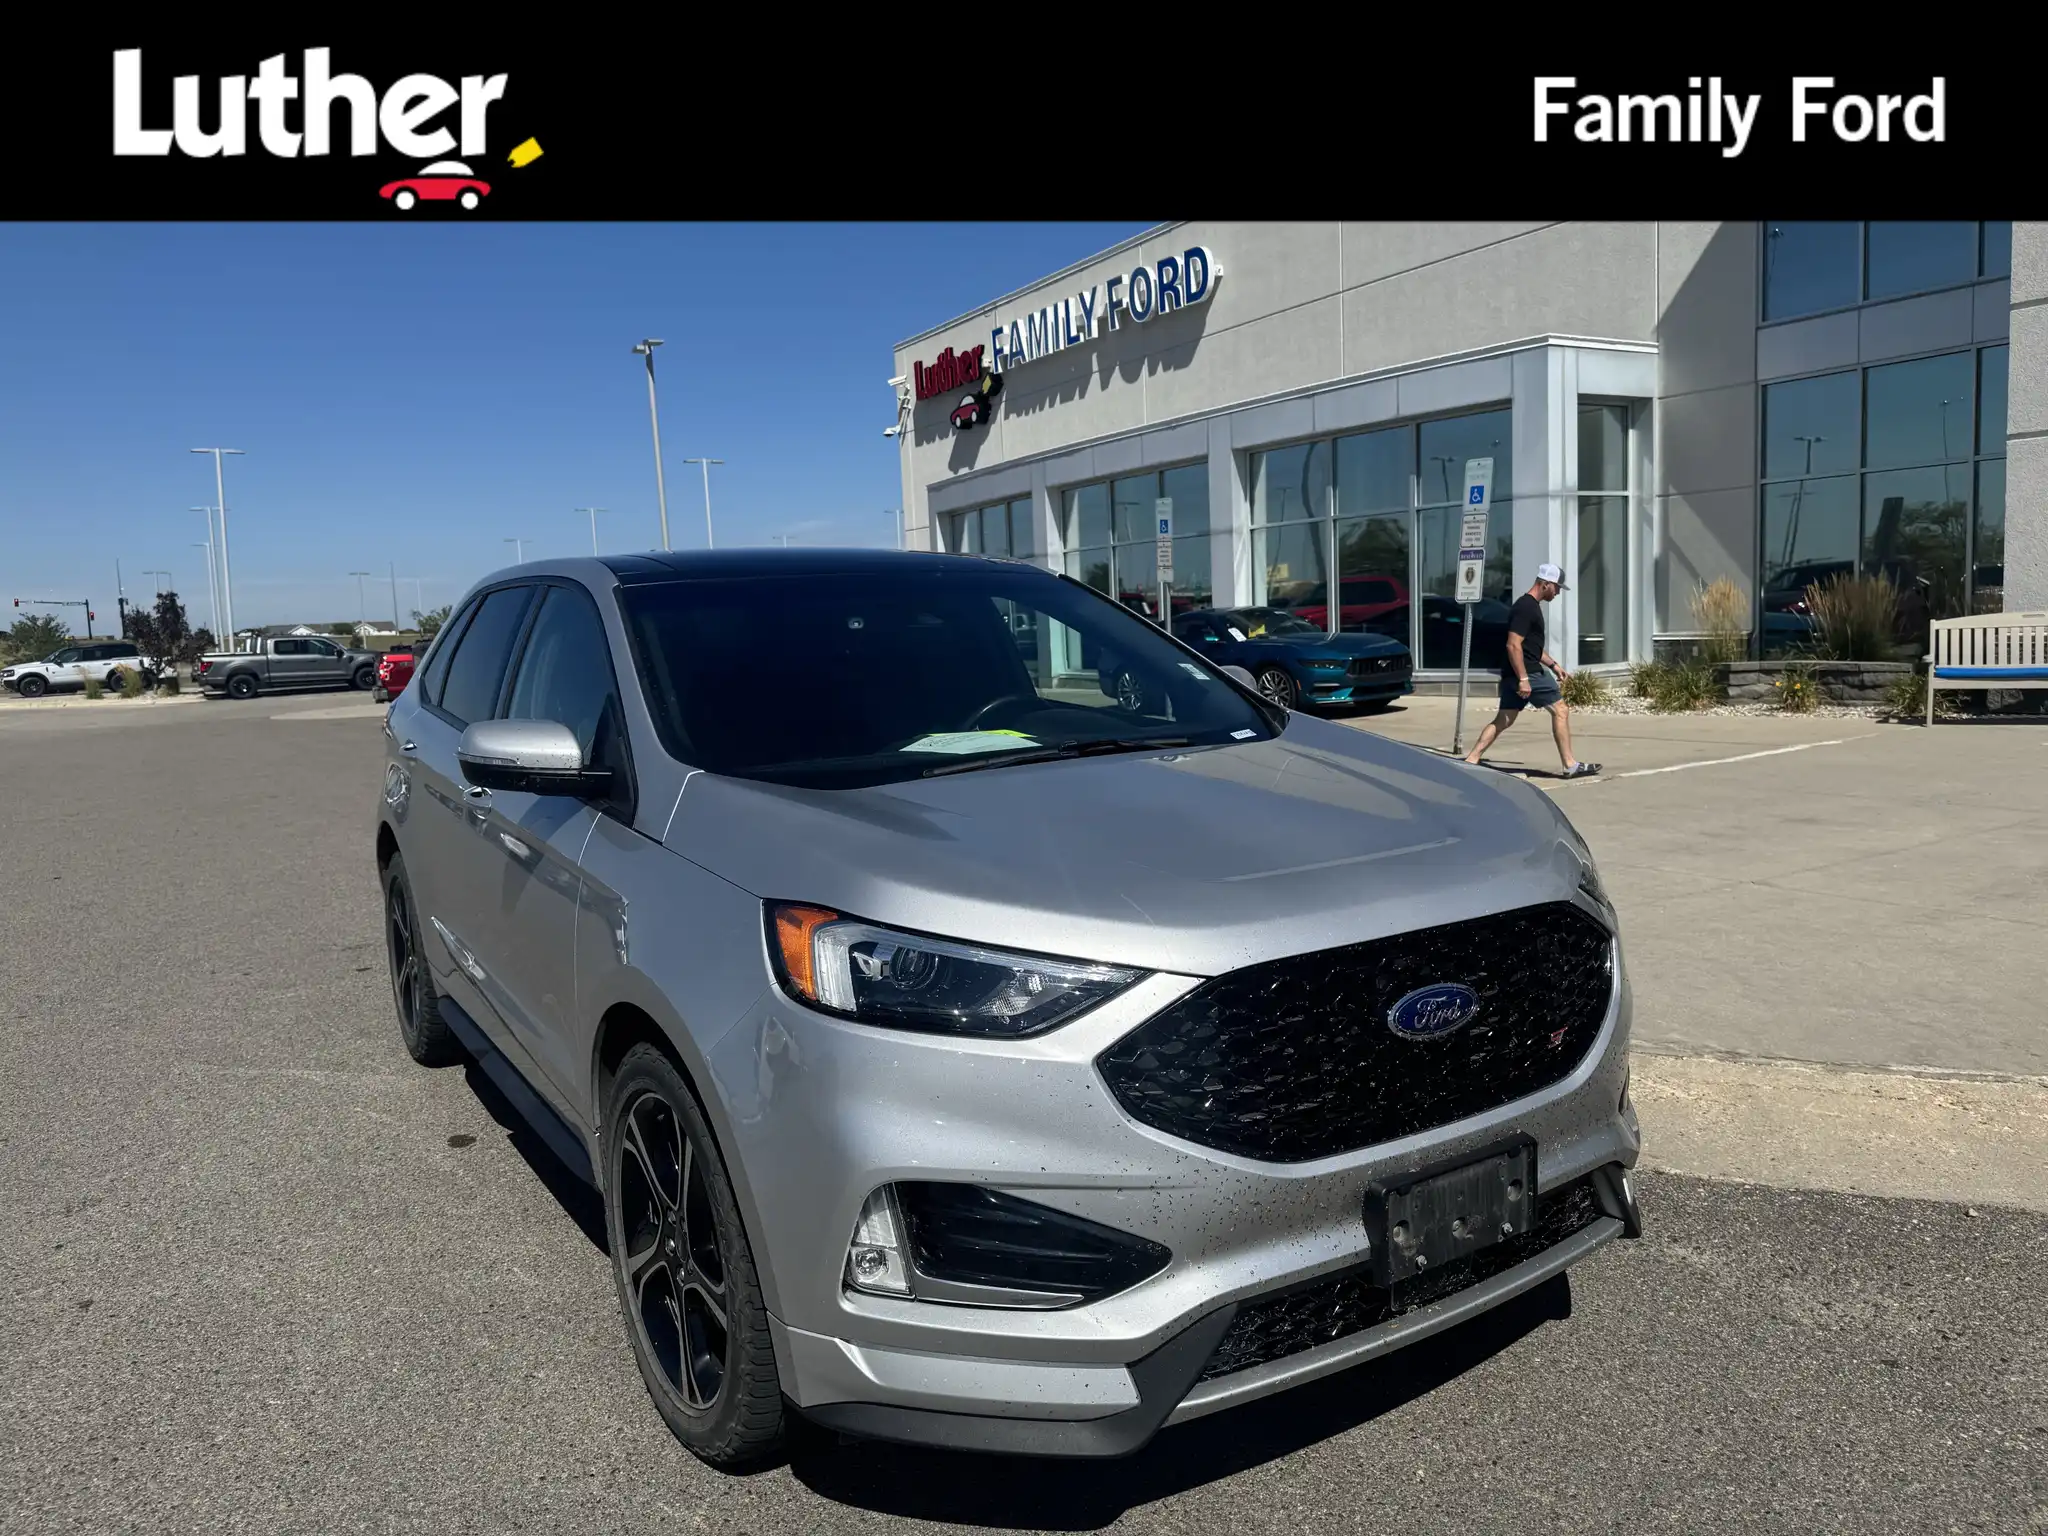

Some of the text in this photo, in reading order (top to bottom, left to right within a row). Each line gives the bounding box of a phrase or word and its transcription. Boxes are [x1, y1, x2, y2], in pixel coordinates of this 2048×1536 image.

[913, 245, 1213, 401] Luther FAMILY FORD
[1414, 996, 1462, 1029] Ford
